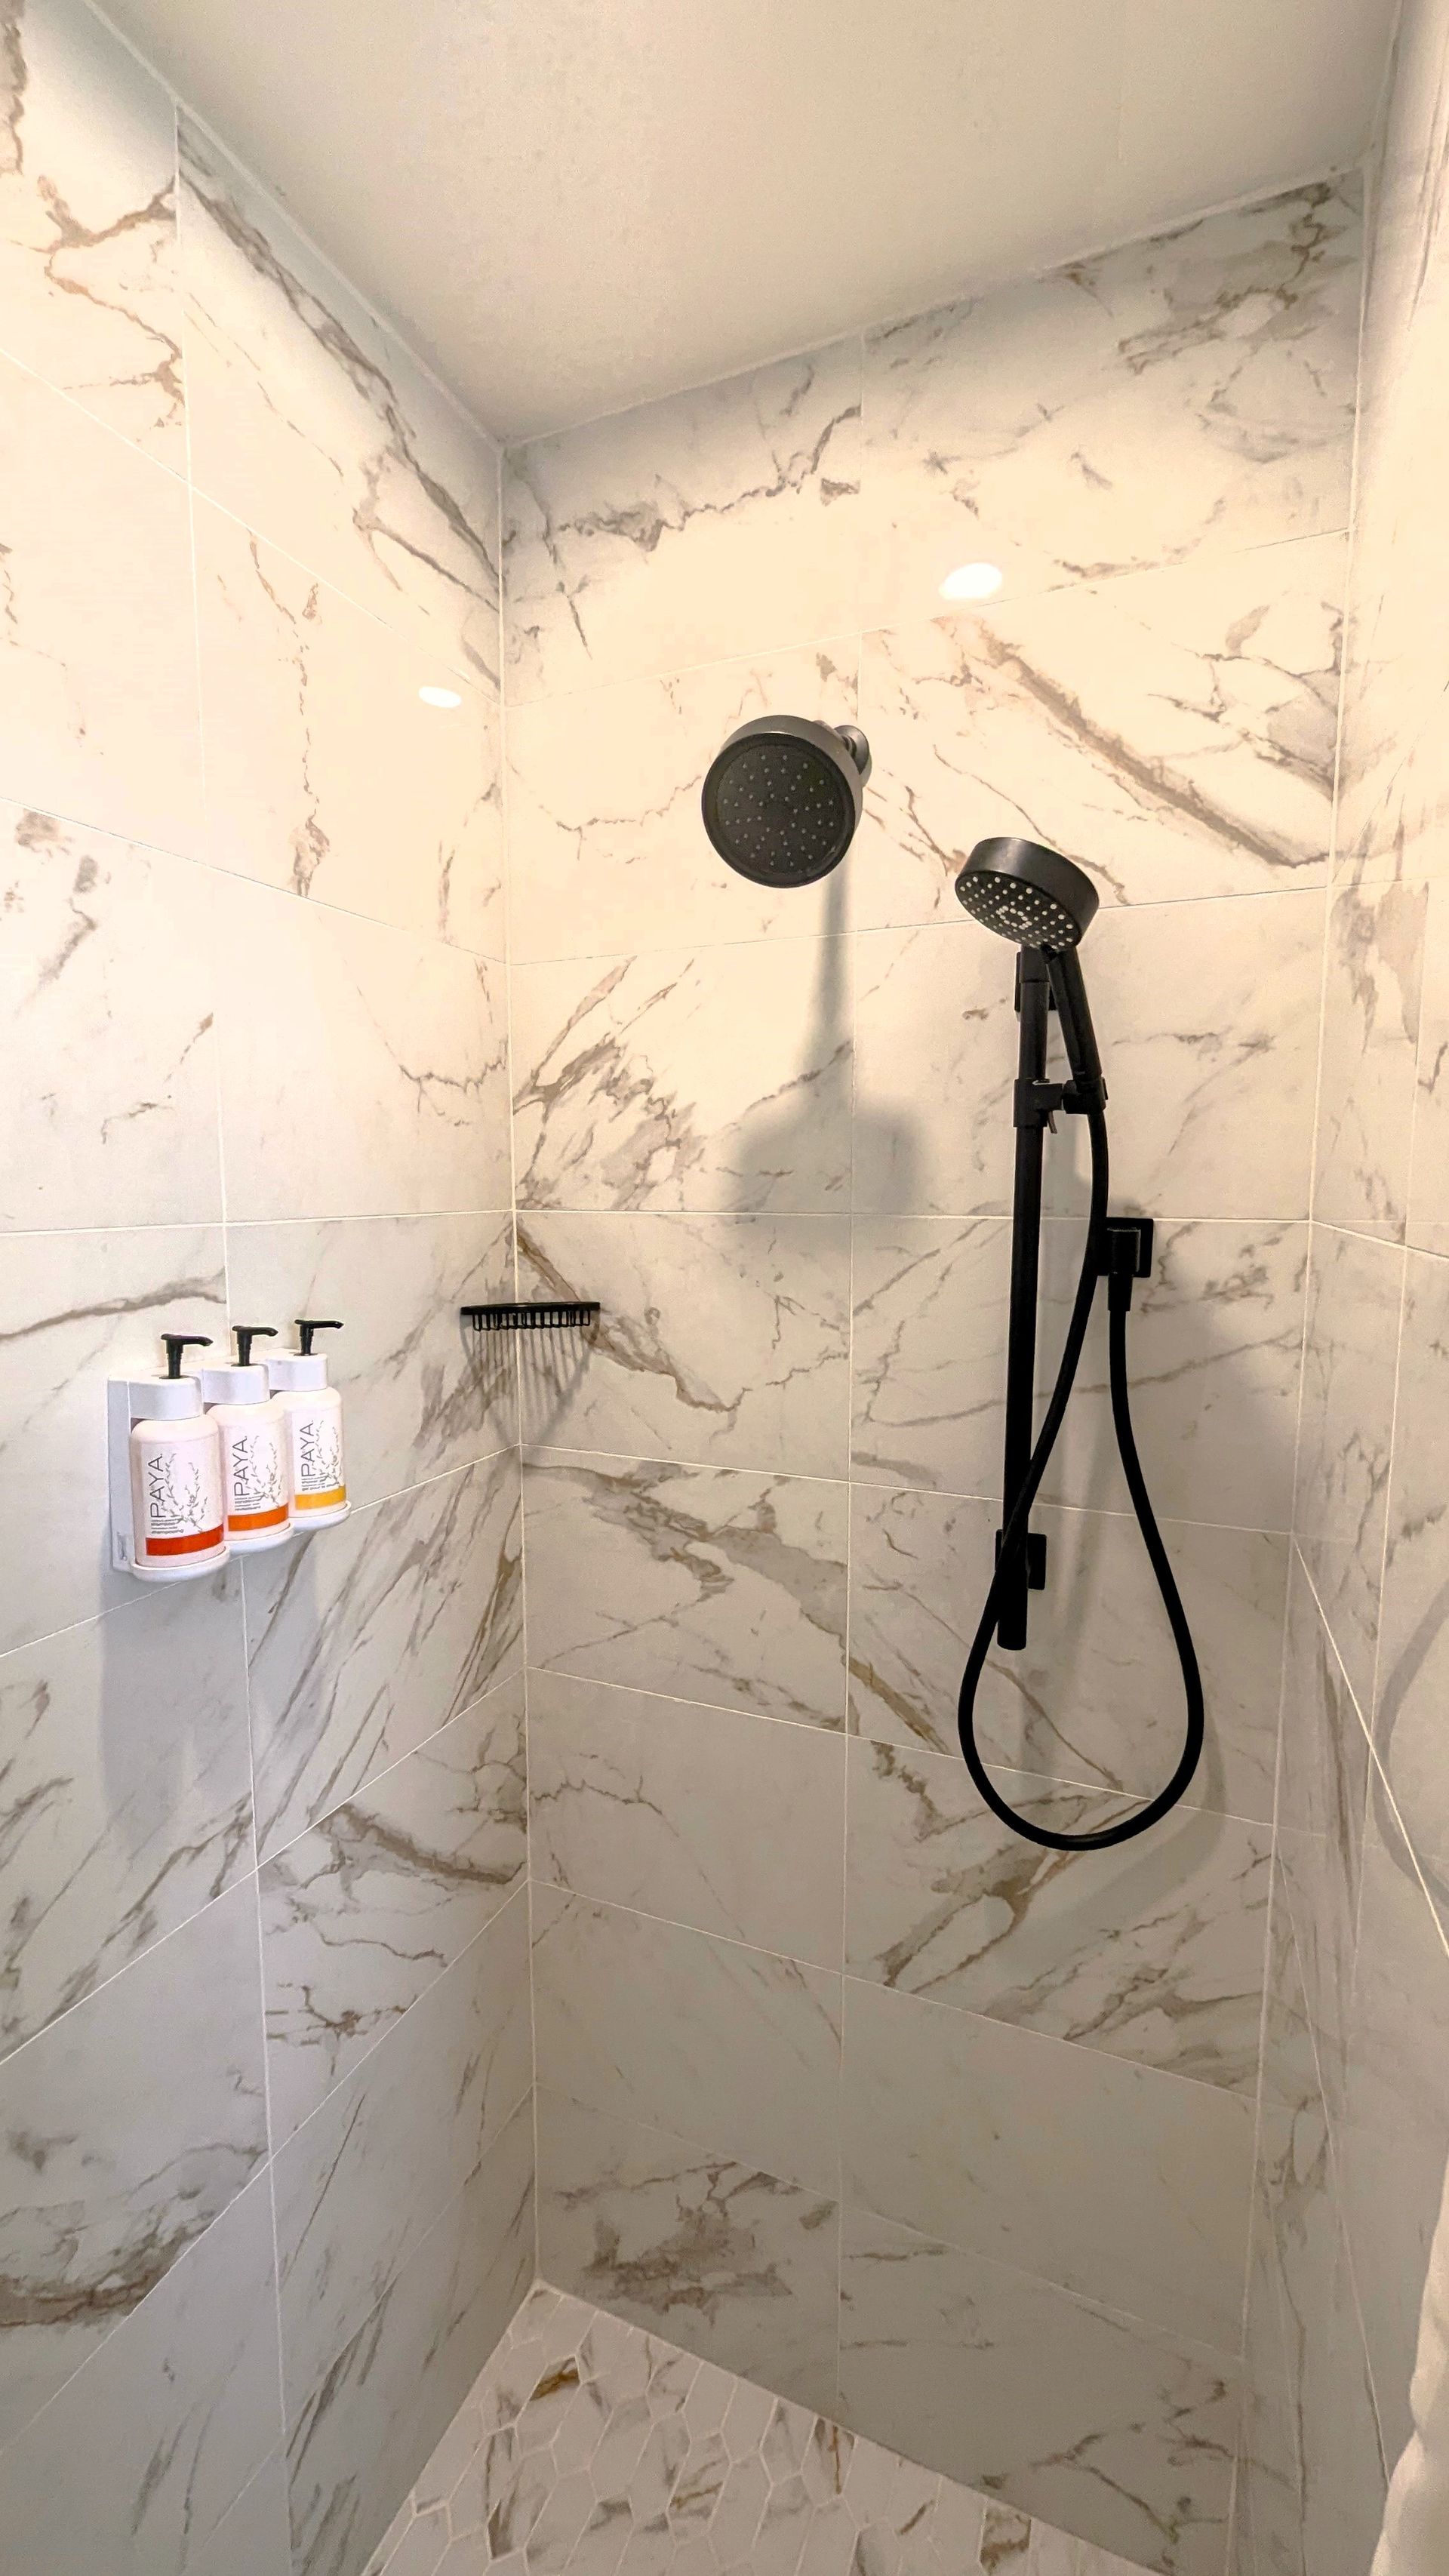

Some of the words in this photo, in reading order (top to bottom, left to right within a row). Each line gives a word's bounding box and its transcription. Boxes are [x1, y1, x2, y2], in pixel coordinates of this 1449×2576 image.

[232, 1438, 250, 1496] PAYA
[300, 1423, 315, 1476] PAYA
[148, 1456, 166, 1517] PAYA
